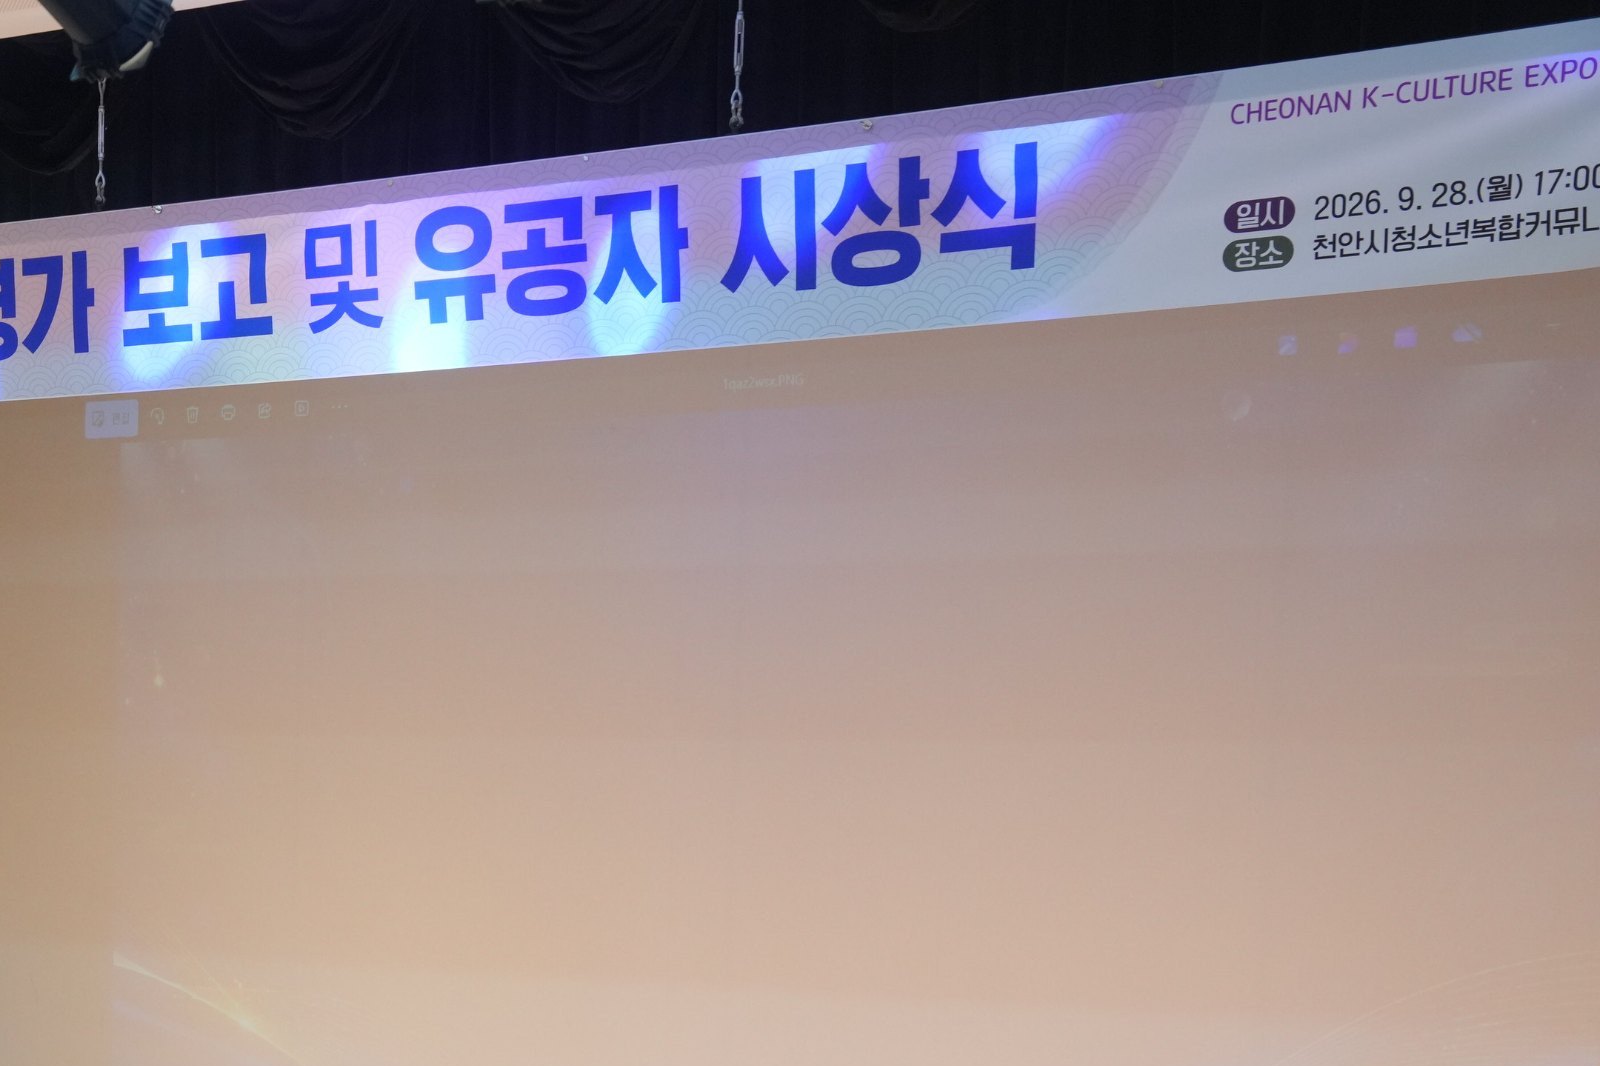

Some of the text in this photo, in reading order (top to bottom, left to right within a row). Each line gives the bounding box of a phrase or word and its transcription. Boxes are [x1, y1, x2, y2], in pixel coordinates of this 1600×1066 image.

[1231, 56, 1599, 125] CHEONAN K-CULTURE EXPO
[1236, 197, 1286, 230] 일시
[1314, 189, 1388, 221] 2026.
[1398, 186, 1422, 212] 9.
[1431, 173, 1523, 208] 28.(월)
[123, 232, 274, 347] 보고
[304, 219, 384, 334] 및
[413, 184, 689, 324] 유공자
[719, 141, 1039, 294] 시상식
[1234, 238, 1285, 269] 장소
